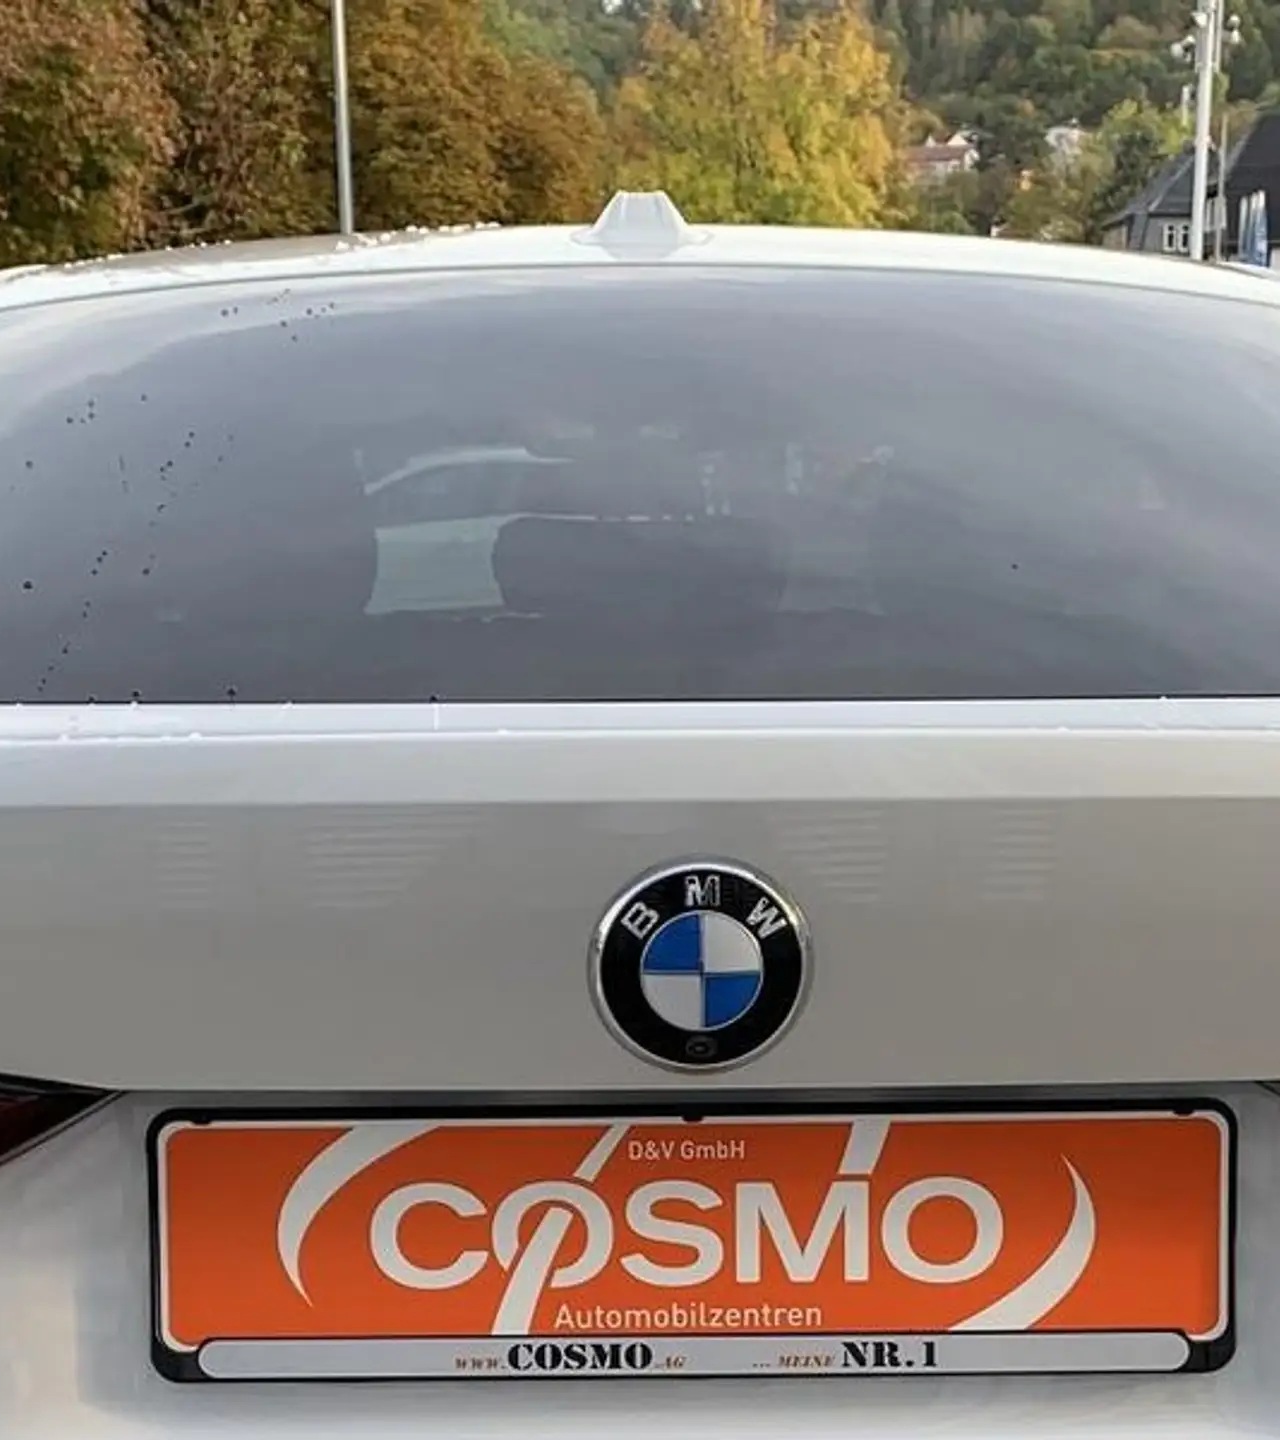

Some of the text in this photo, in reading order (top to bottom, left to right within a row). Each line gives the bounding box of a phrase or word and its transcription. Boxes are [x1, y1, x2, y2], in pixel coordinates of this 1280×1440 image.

[621, 875, 787, 939] BMW
[628, 1140, 746, 1161] D&V GmbH
[370, 1176, 1004, 1290] COSMO
[554, 1302, 822, 1329] Automobilzentren
